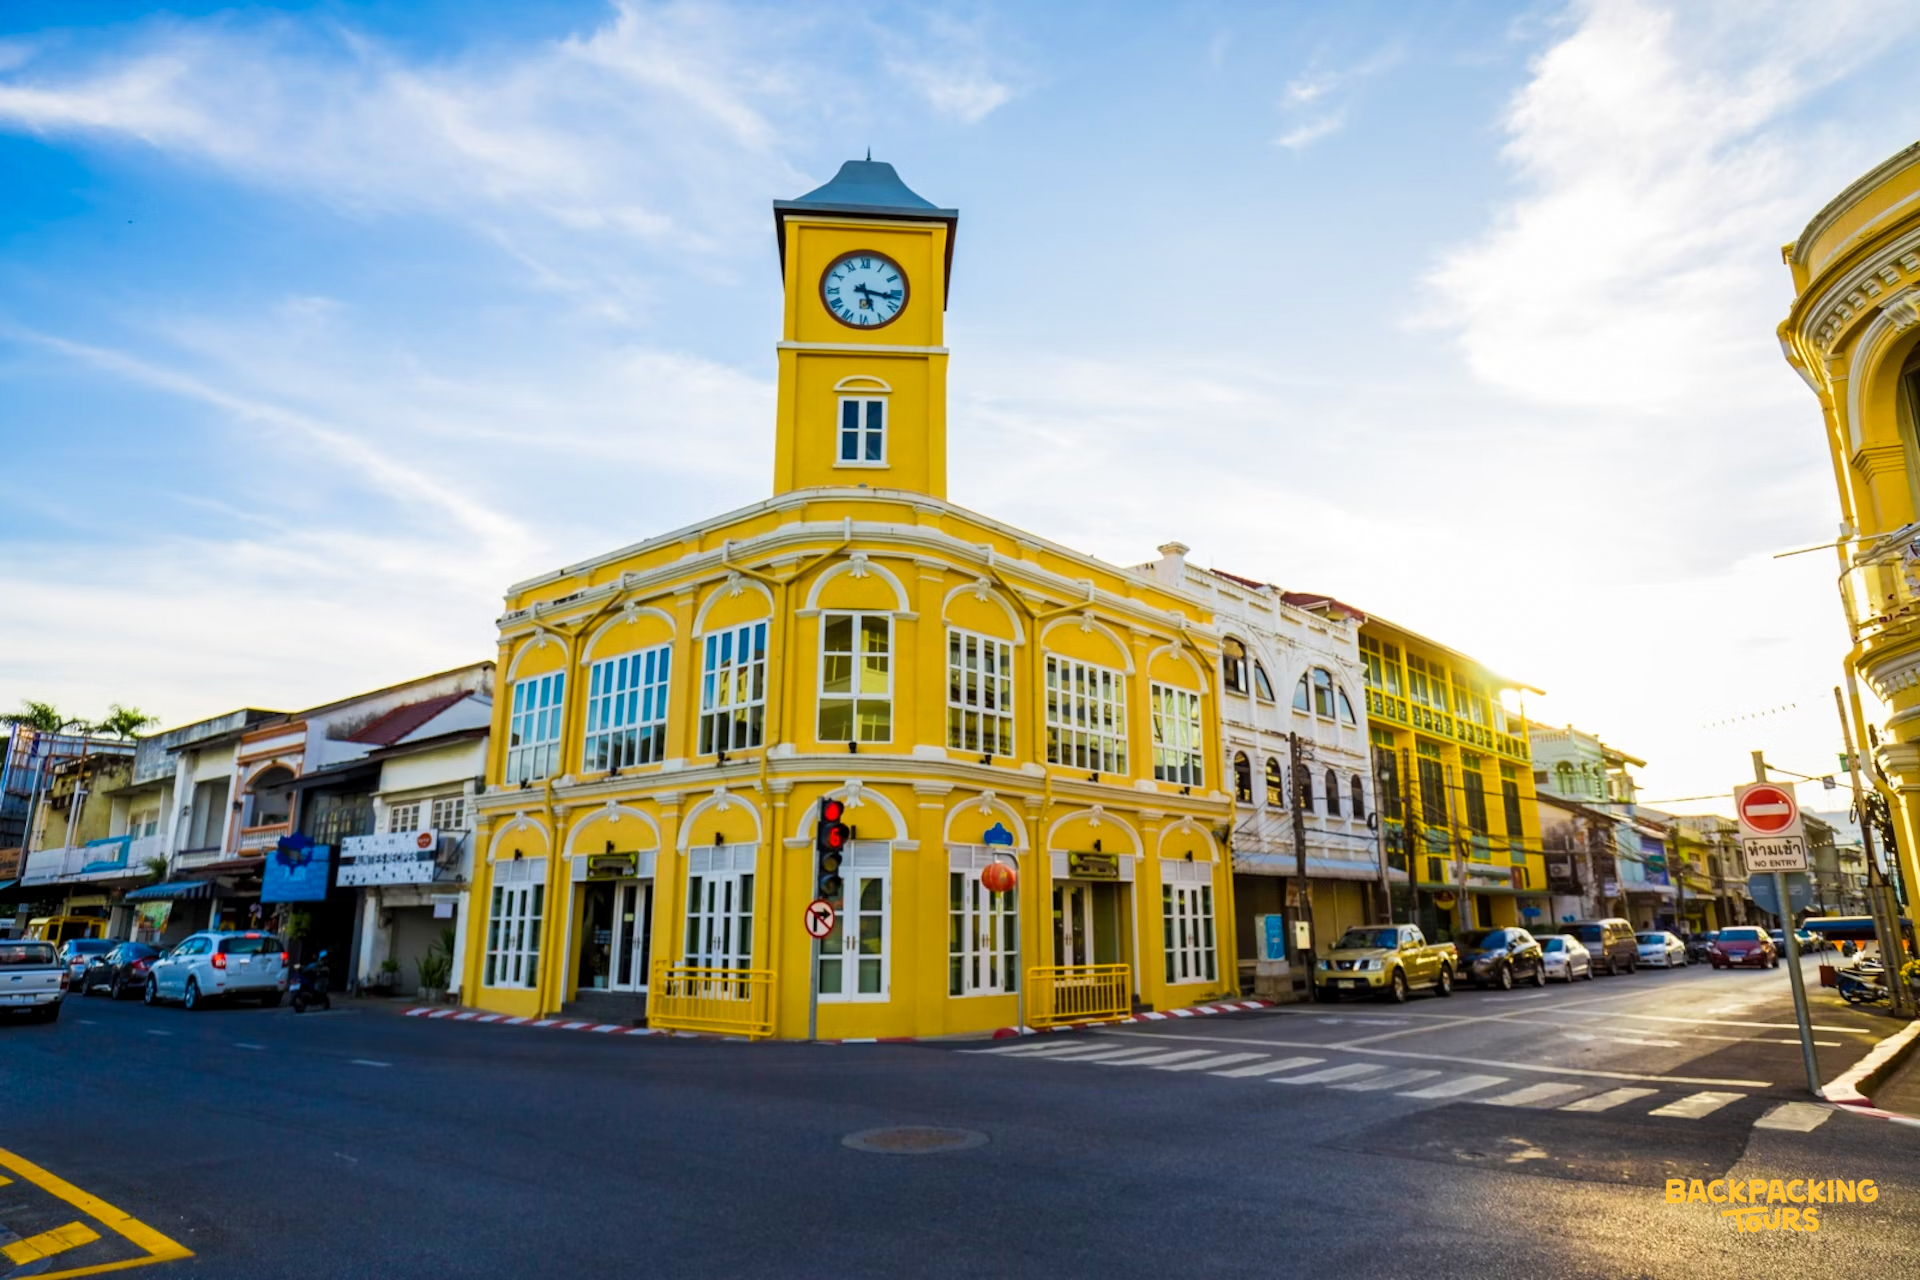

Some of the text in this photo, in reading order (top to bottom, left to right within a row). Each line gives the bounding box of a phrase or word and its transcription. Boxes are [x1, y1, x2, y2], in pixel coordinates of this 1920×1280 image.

[844, 261, 856, 273] XI
[860, 258, 870, 269] XII
[832, 272, 844, 282] X
[828, 286, 840, 295] IX
[829, 827, 841, 848] 6
[1748, 840, 1801, 856] ห้ามเข้า
